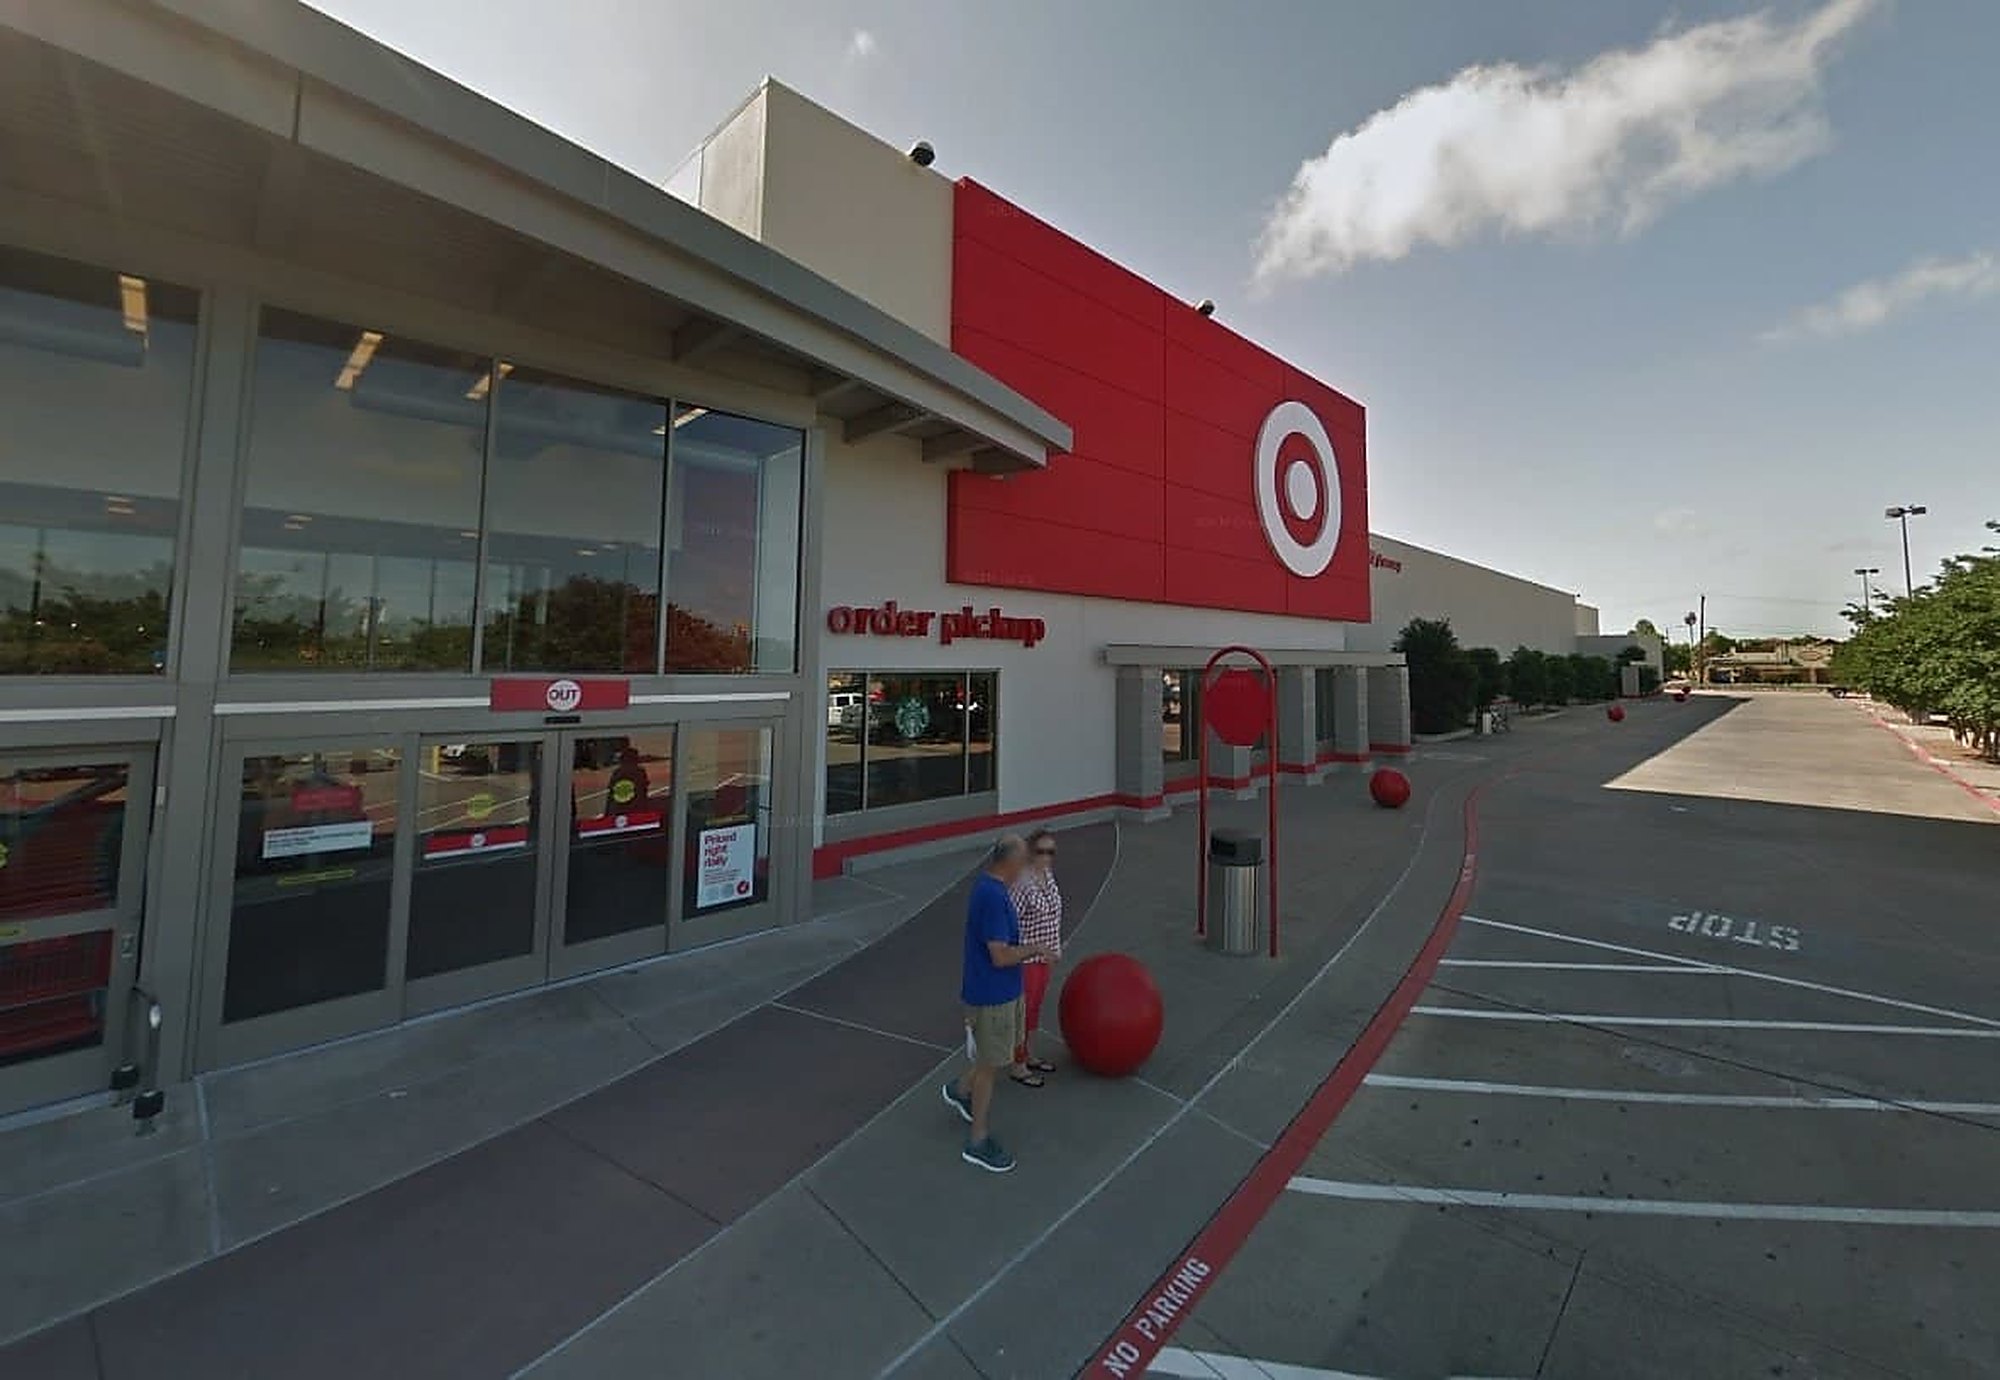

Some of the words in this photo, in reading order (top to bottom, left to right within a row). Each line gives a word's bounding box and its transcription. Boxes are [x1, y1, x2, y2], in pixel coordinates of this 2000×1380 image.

[828, 600, 936, 637] order
[940, 605, 1045, 648] pickup
[549, 689, 579, 702] OUT
[1667, 911, 1799, 950] STOP
[1103, 1341, 1139, 1380] NO
[1135, 1258, 1211, 1341] PARKING
